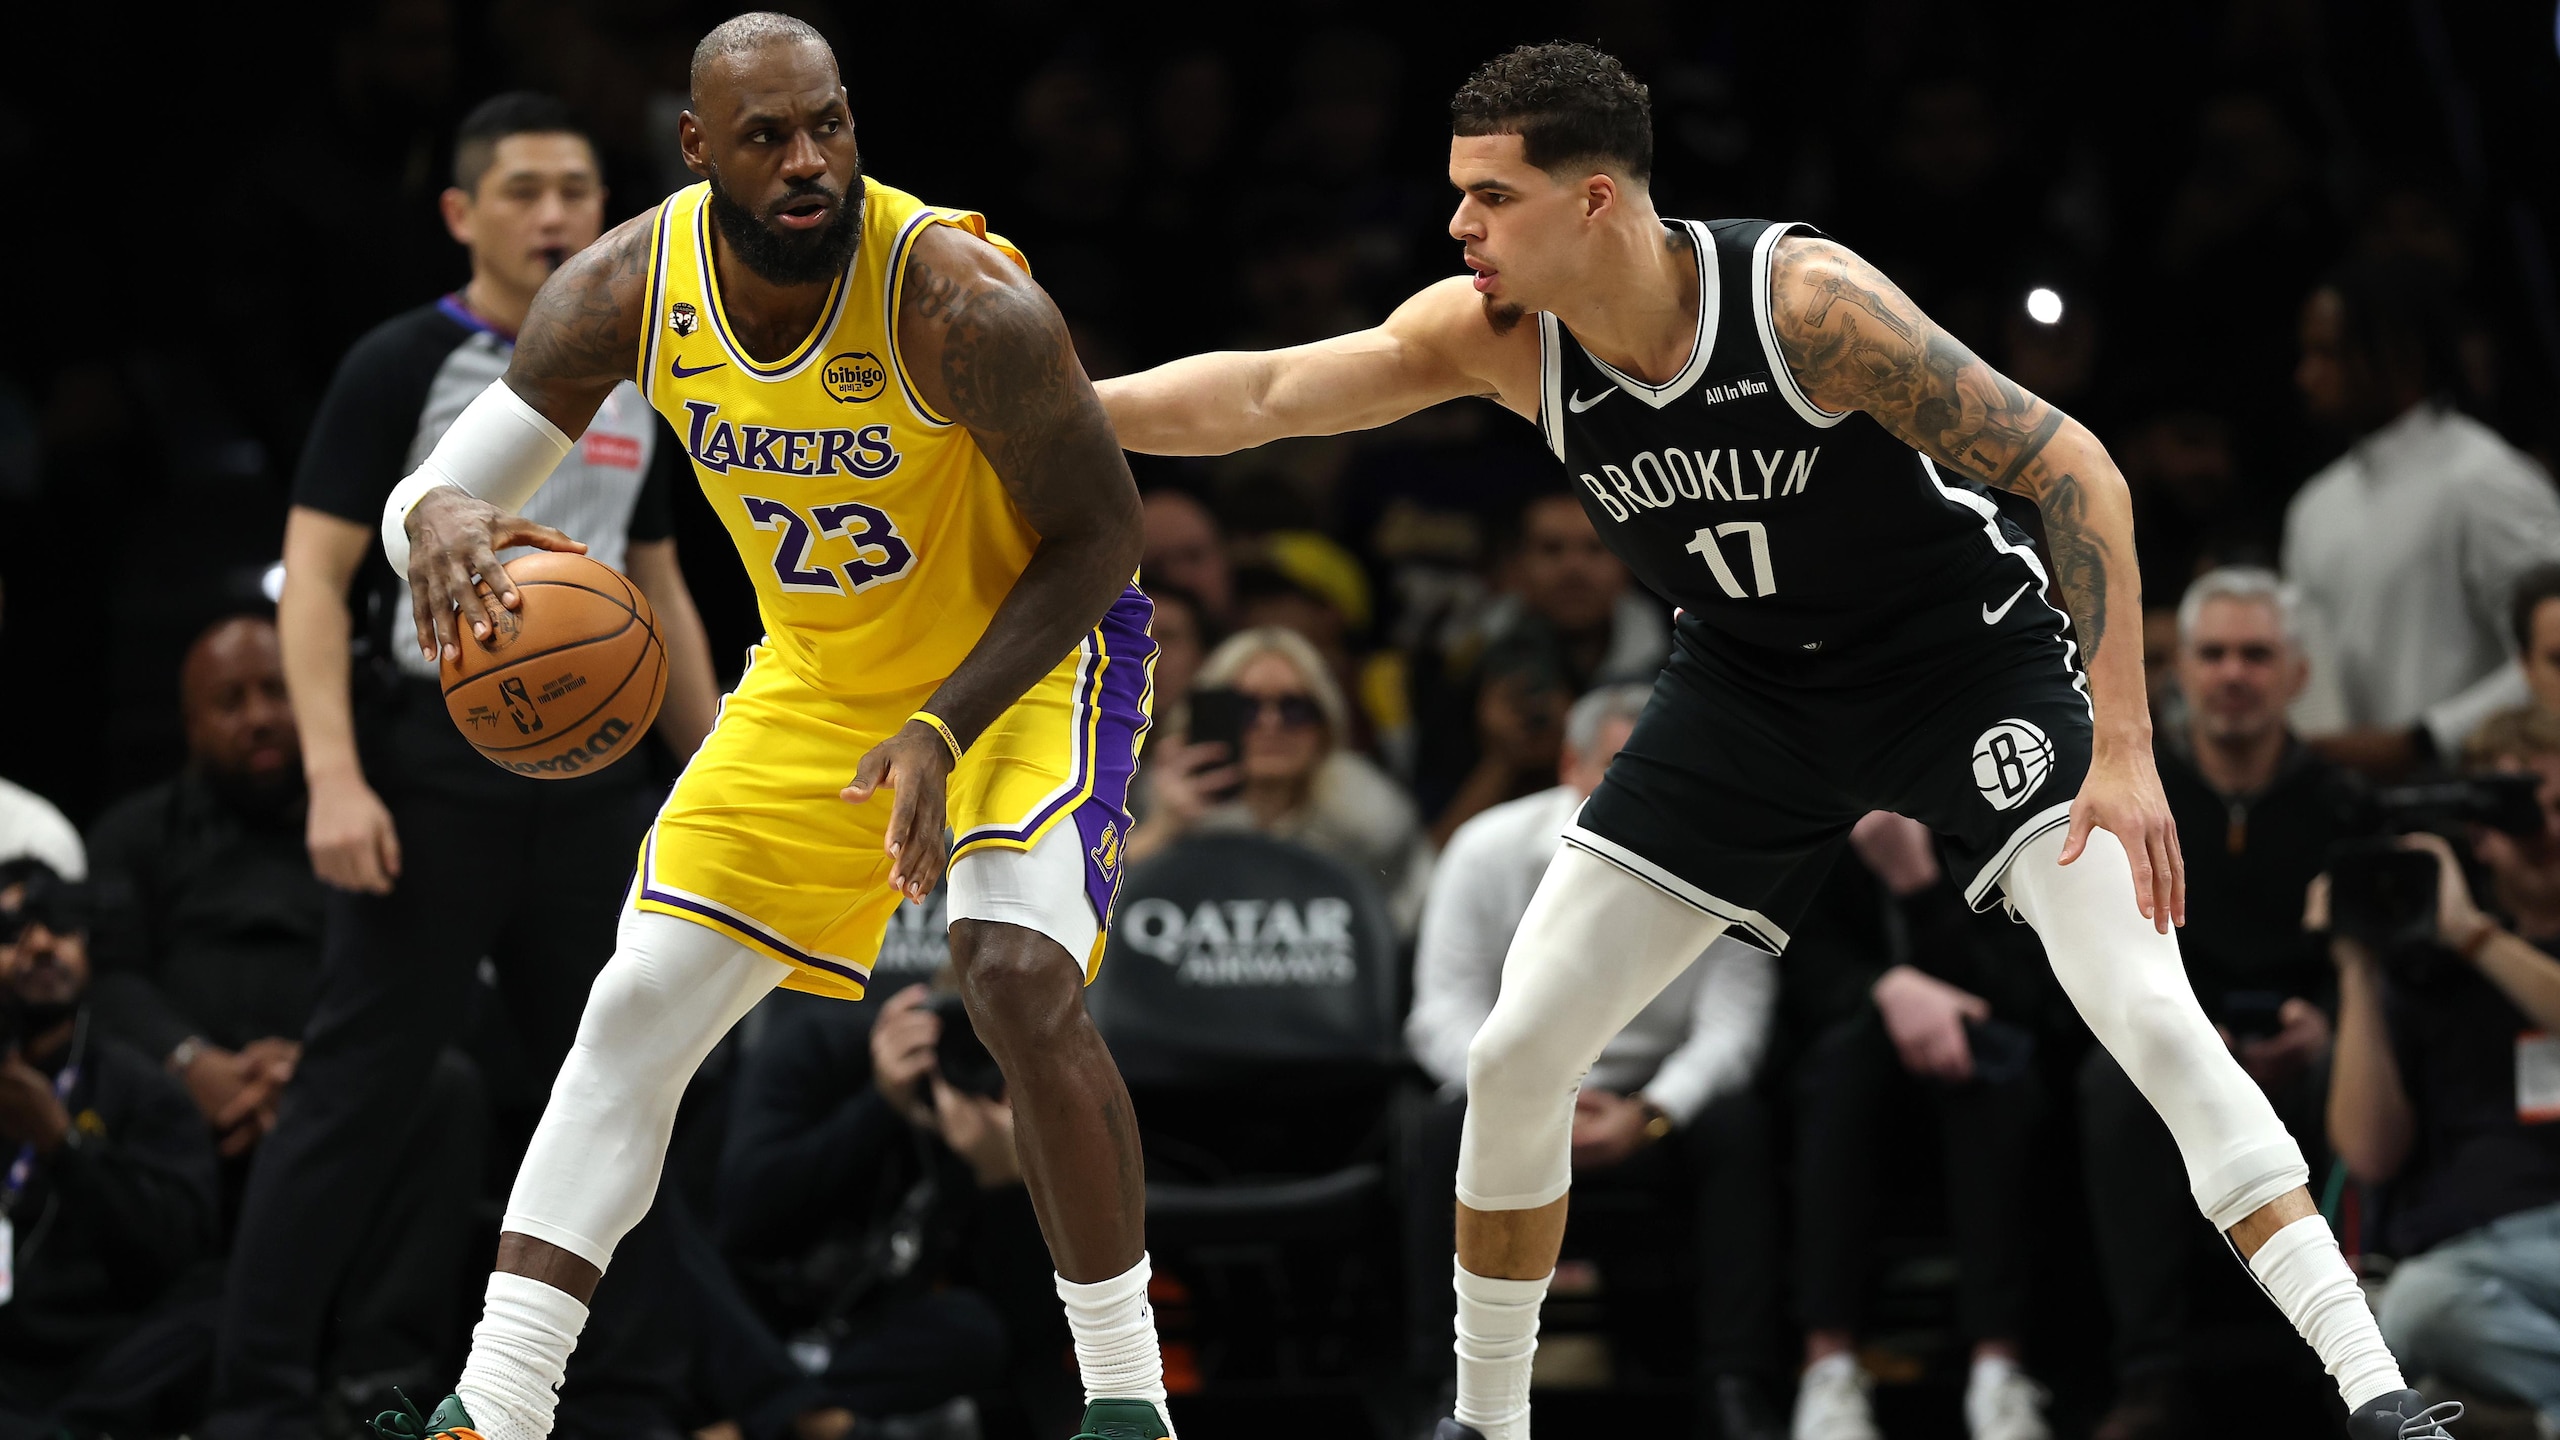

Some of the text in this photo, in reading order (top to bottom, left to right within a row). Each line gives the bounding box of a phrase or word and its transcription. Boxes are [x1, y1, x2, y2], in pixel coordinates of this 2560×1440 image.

[828, 366, 883, 387] bibigo
[839, 384, 862, 392] 비비고
[1705, 379, 1768, 405] All In Won
[683, 399, 902, 481] LAKERS
[1579, 446, 1820, 523] BROOKLYN
[739, 495, 918, 597] 23
[1685, 522, 1777, 598] 17
[1989, 732, 2028, 800] B
[1121, 898, 1354, 966] QATAR
